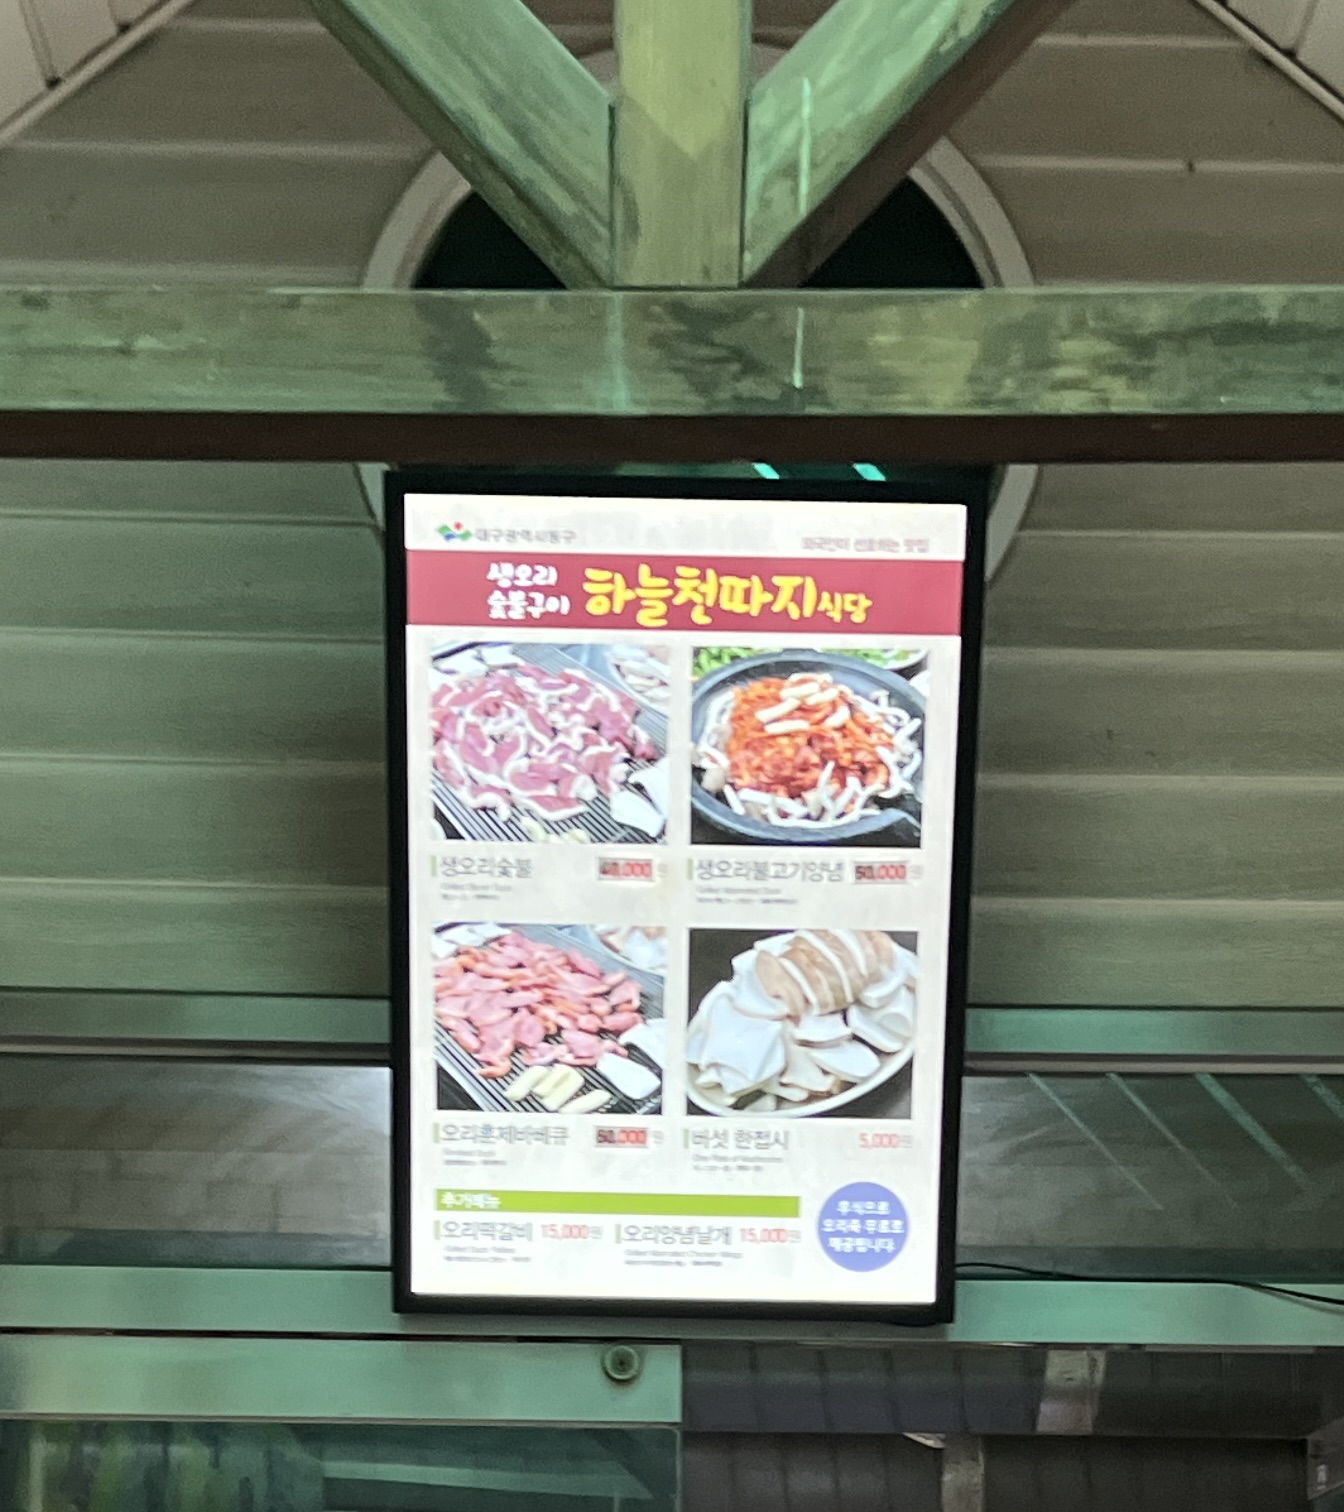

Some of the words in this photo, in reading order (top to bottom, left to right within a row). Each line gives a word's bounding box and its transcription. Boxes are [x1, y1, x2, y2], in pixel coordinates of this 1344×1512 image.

[486, 561, 558, 588] 생오리
[486, 589, 572, 620] 숯불구이
[691, 1128, 729, 1150] 버섯
